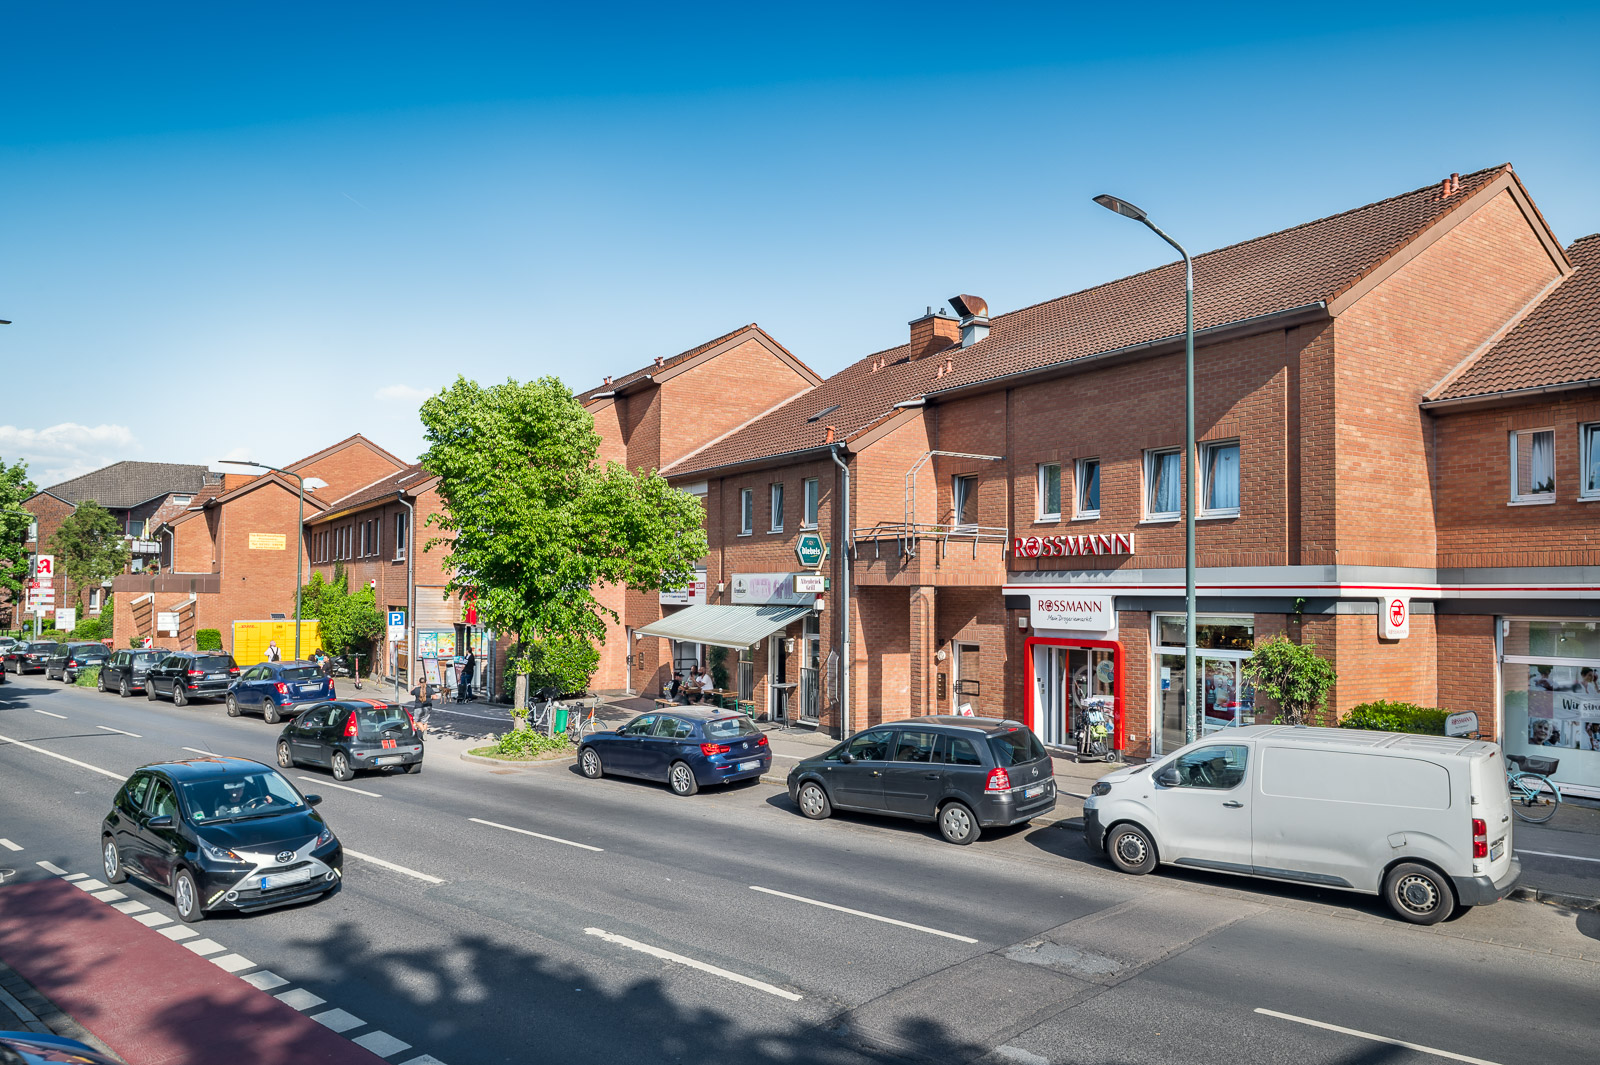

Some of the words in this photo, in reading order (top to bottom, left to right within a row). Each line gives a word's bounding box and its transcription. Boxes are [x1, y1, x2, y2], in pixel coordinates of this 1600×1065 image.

[1014, 533, 1135, 558] ROSSMANN
[1038, 599, 1102, 613] ROSSMANN
[391, 613, 401, 625] P
[1058, 614, 1092, 624] Drogeriemarkt
[1562, 698, 1580, 711] Wir
